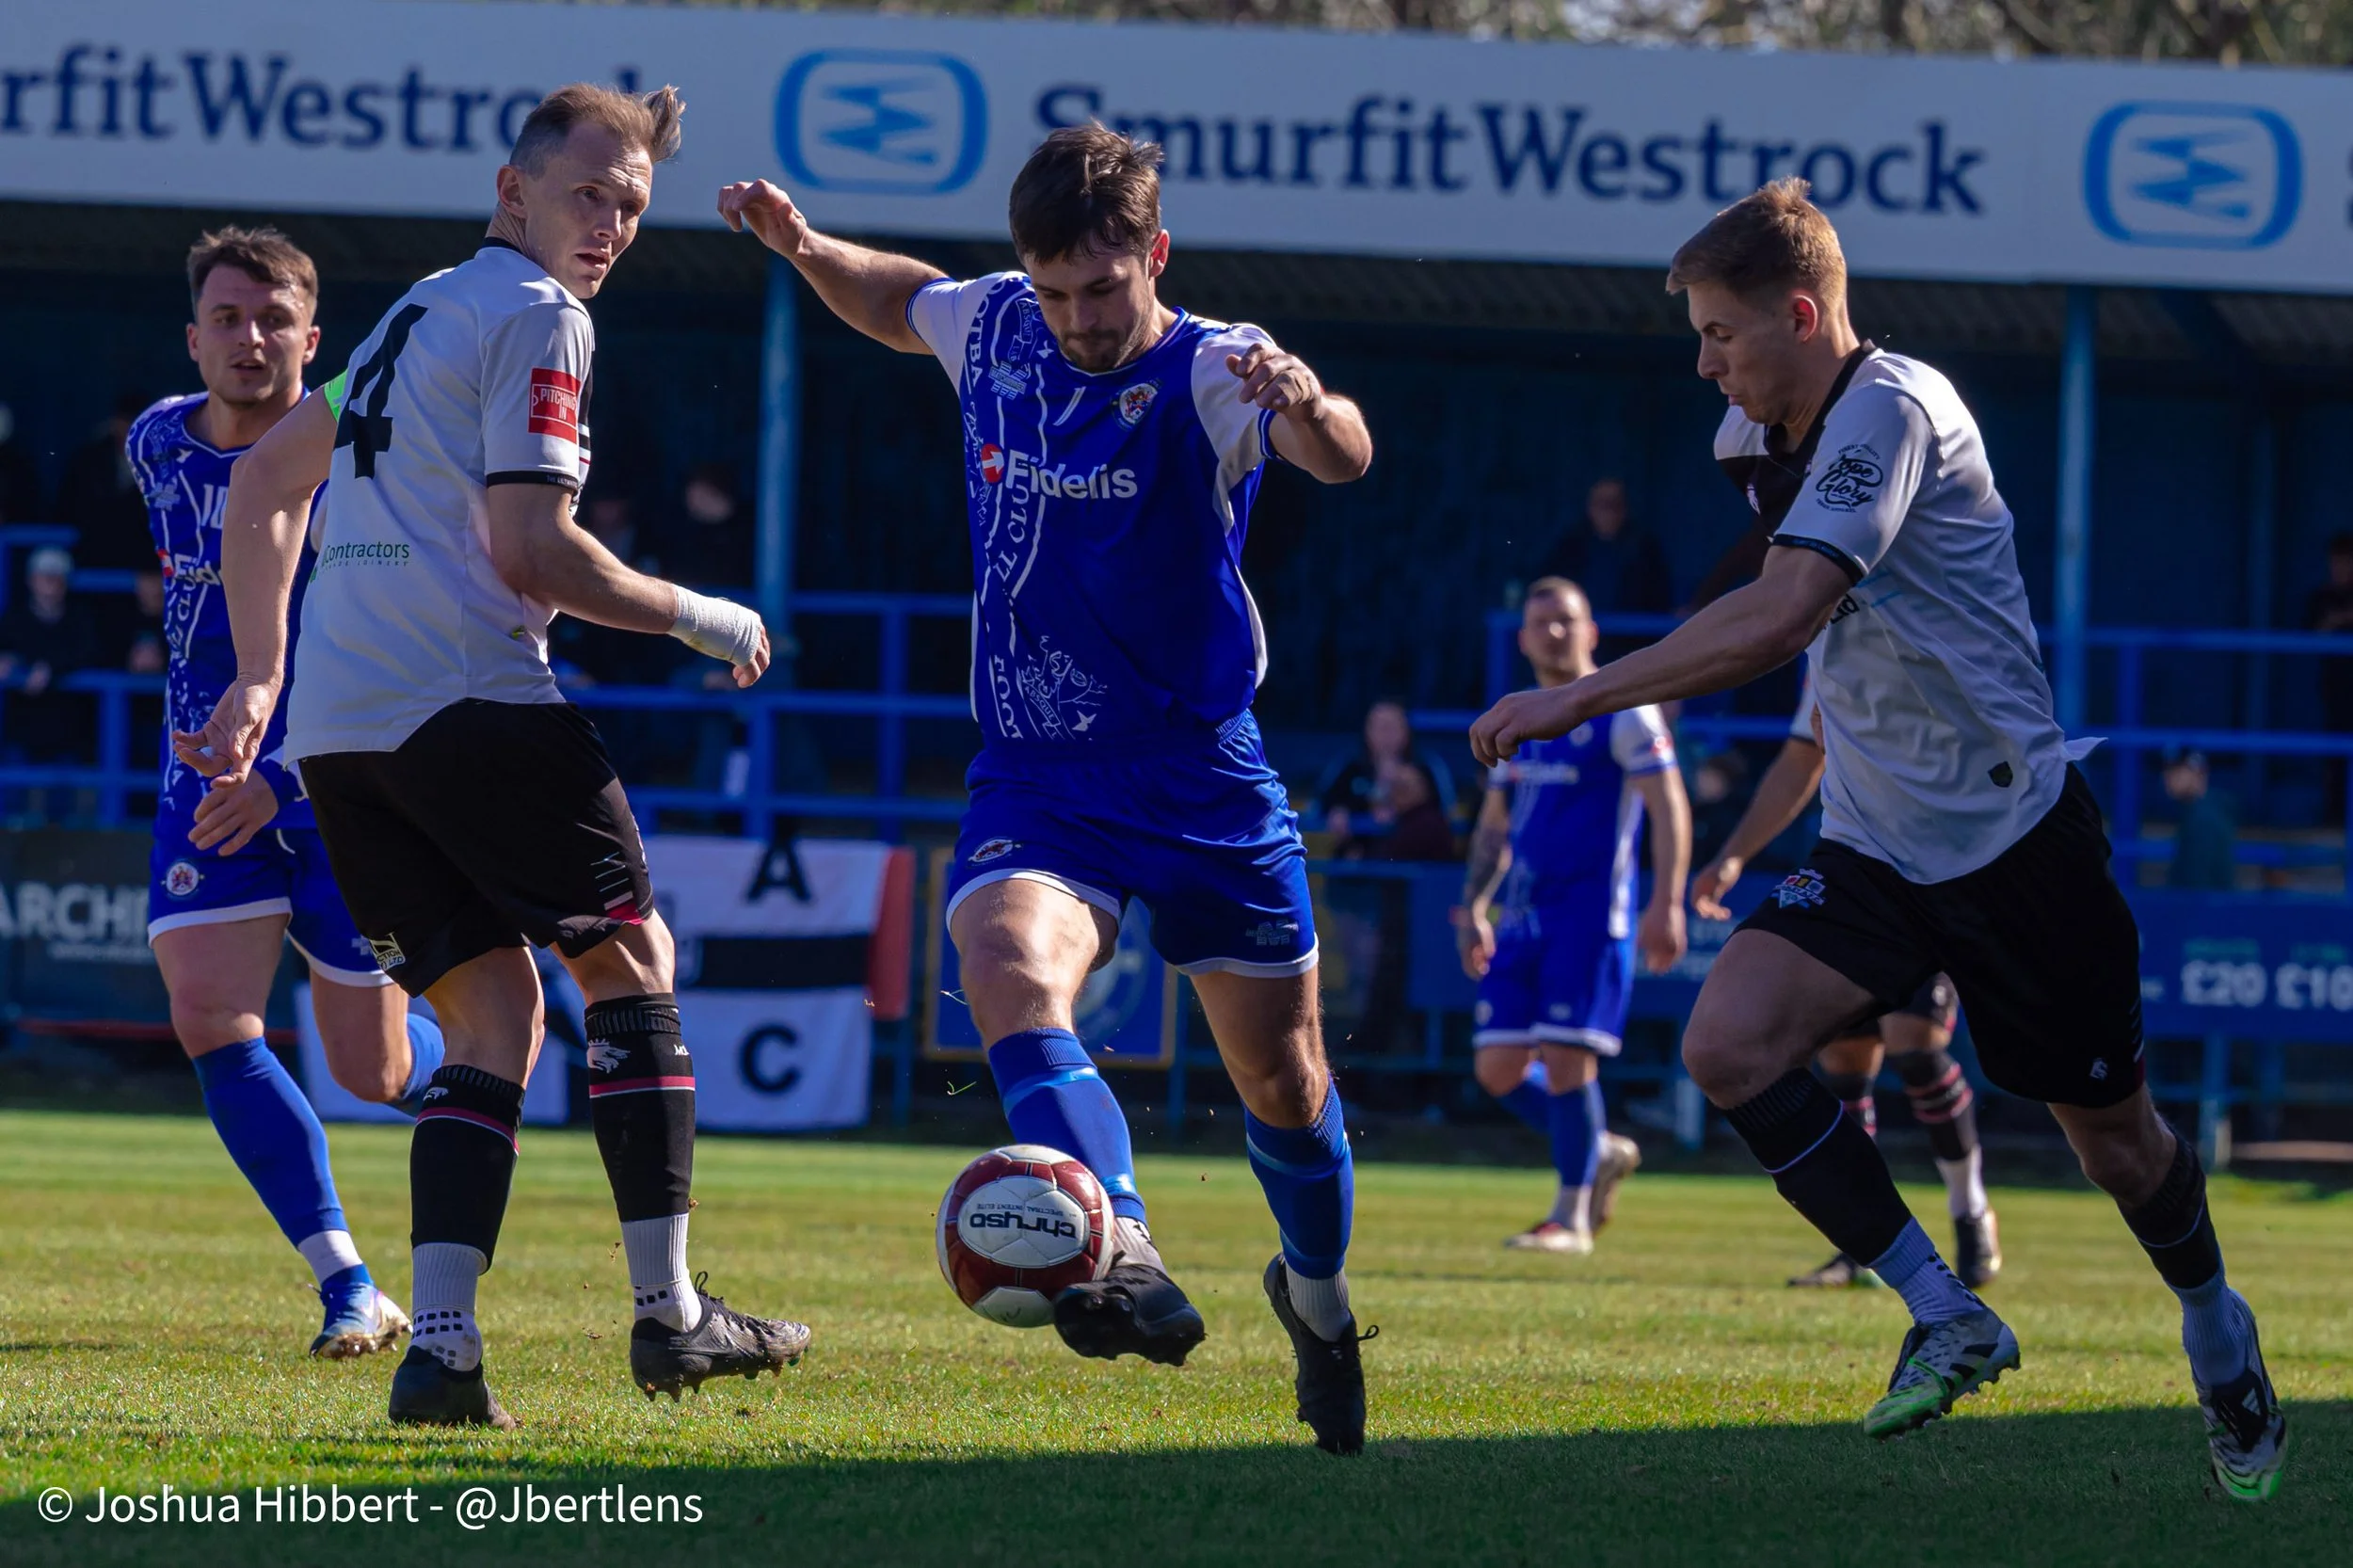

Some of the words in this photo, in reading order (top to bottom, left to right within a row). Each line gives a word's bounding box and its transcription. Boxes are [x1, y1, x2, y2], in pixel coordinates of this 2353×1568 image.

[0, 41, 643, 154] rfitWestro
[333, 303, 429, 480] 4
[539, 387, 578, 411] PITCHING
[558, 403, 568, 421] IN
[1004, 449, 1139, 500] Fidelis
[1816, 470, 1875, 508] Glory
[745, 830, 813, 904] A
[2180, 958, 2267, 1008] £20
[740, 1022, 803, 1095] C
[1026, 1205, 1064, 1217] SPECTRAL
